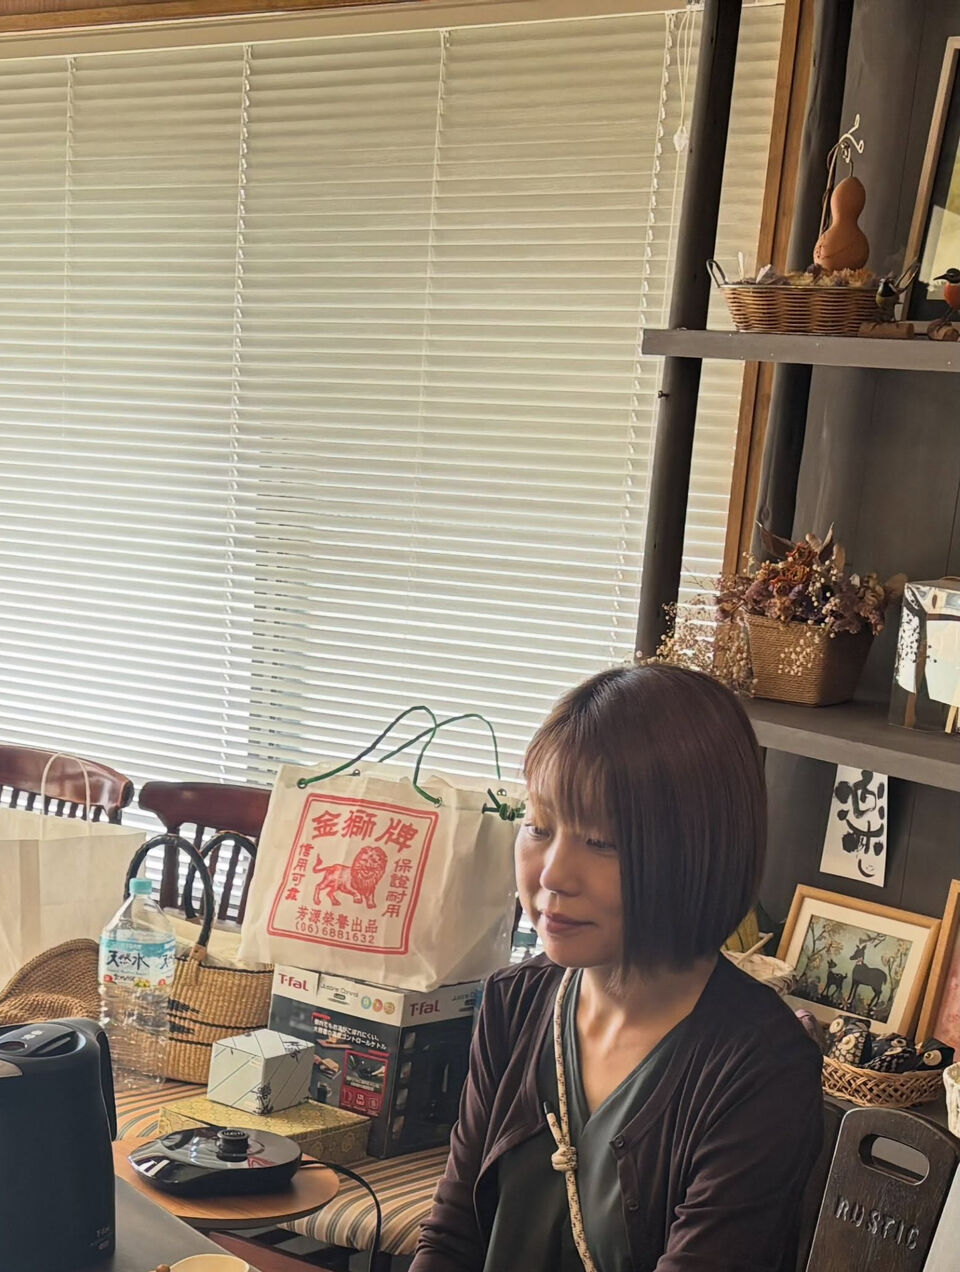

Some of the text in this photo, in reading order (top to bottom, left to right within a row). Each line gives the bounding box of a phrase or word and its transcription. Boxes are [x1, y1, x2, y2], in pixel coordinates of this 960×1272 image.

[312, 809, 419, 853] 金獅牌
[382, 858, 413, 918] 保證耐用
[106, 950, 150, 970] 天然水
[835, 1196, 920, 1250] RUSTIC
